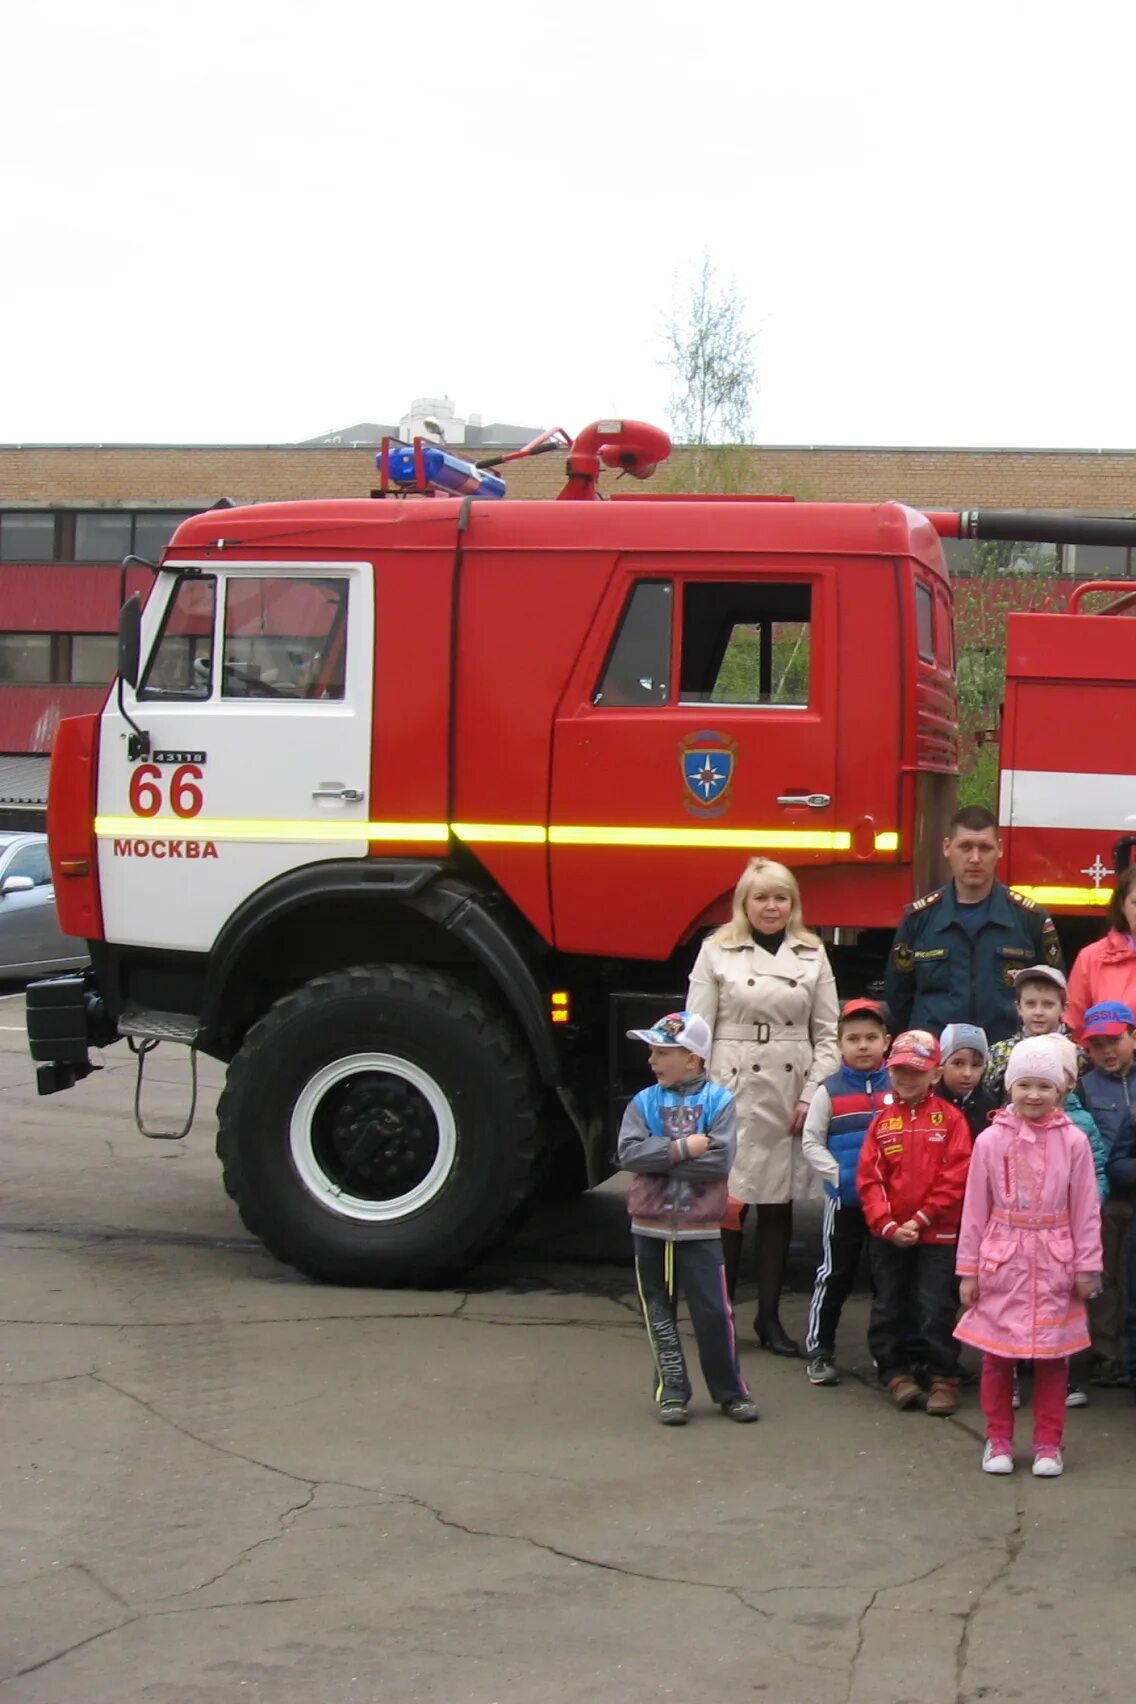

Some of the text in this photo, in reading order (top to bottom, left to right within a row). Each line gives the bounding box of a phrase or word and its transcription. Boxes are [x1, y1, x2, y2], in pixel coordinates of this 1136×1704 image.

[155, 753, 203, 762] 43118
[129, 763, 204, 818] 66
[113, 839, 219, 859] МОСКВА
